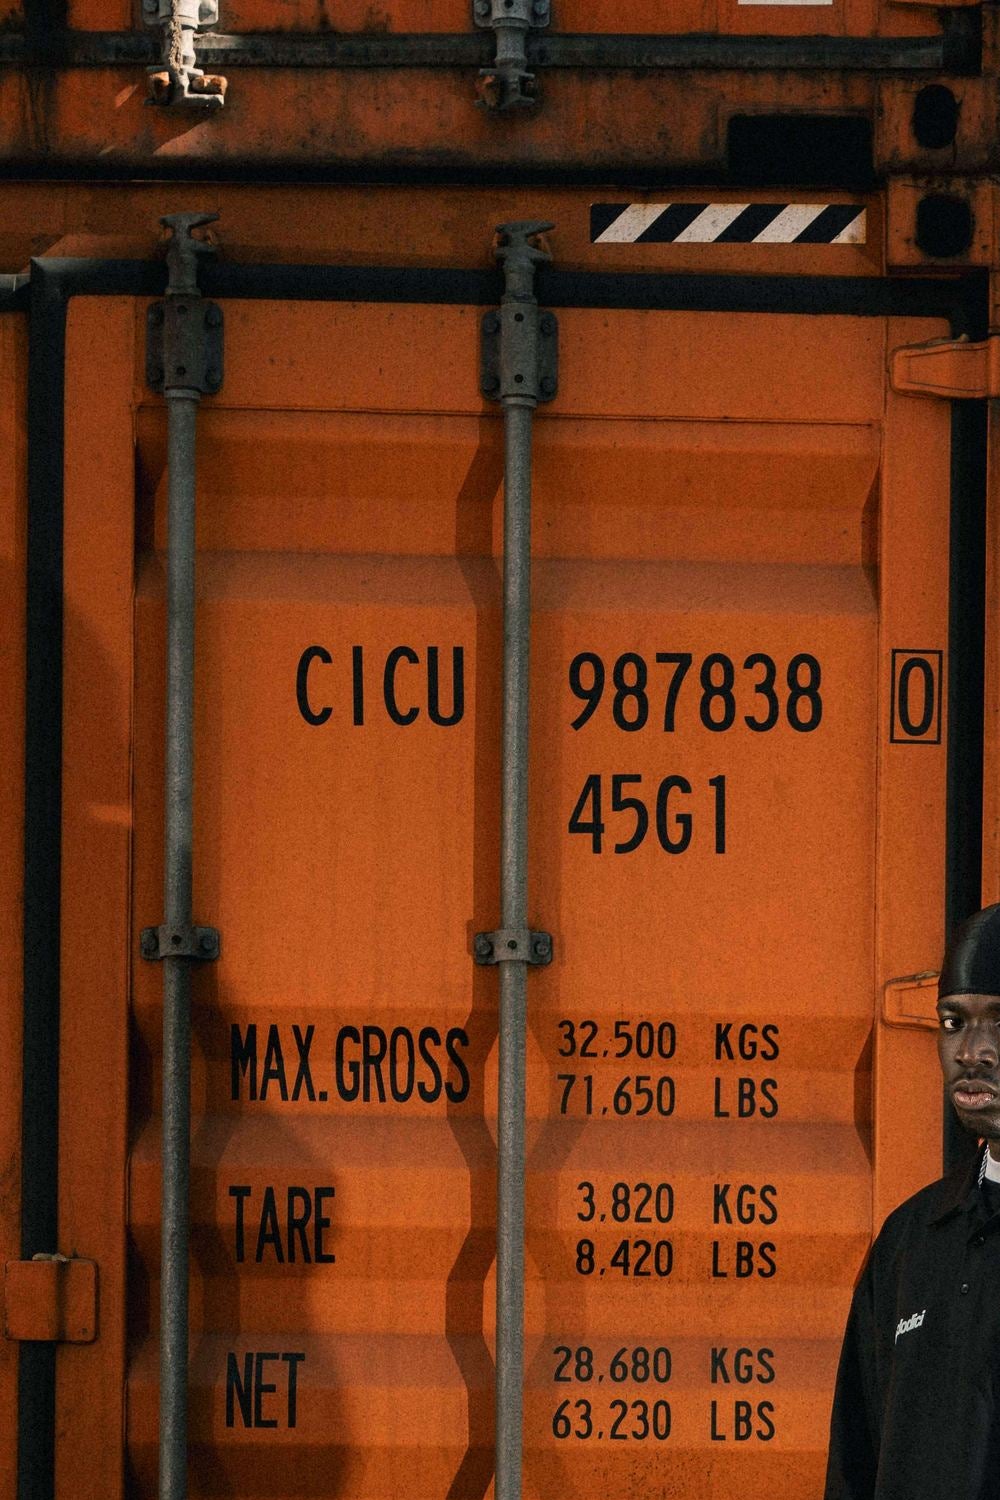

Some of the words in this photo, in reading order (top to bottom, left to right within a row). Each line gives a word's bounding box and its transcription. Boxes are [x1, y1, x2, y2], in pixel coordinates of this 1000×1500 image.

[296, 646, 464, 726] CICU
[569, 652, 822, 732] 987838
[899, 658, 934, 736] 0
[568, 774, 725, 854] 45G1
[558, 1020, 676, 1059] 32,500
[715, 1023, 779, 1060] KGS
[230, 1024, 470, 1104] MAX.GROSS
[557, 1074, 675, 1116] 71,650
[715, 1077, 778, 1118] LBS
[229, 1186, 335, 1265] TARE
[714, 1184, 777, 1225] KGS
[712, 1241, 776, 1278] LBS
[711, 1348, 775, 1383] KGS
[226, 1350, 305, 1428] NET
[711, 1401, 775, 1441] LBS
